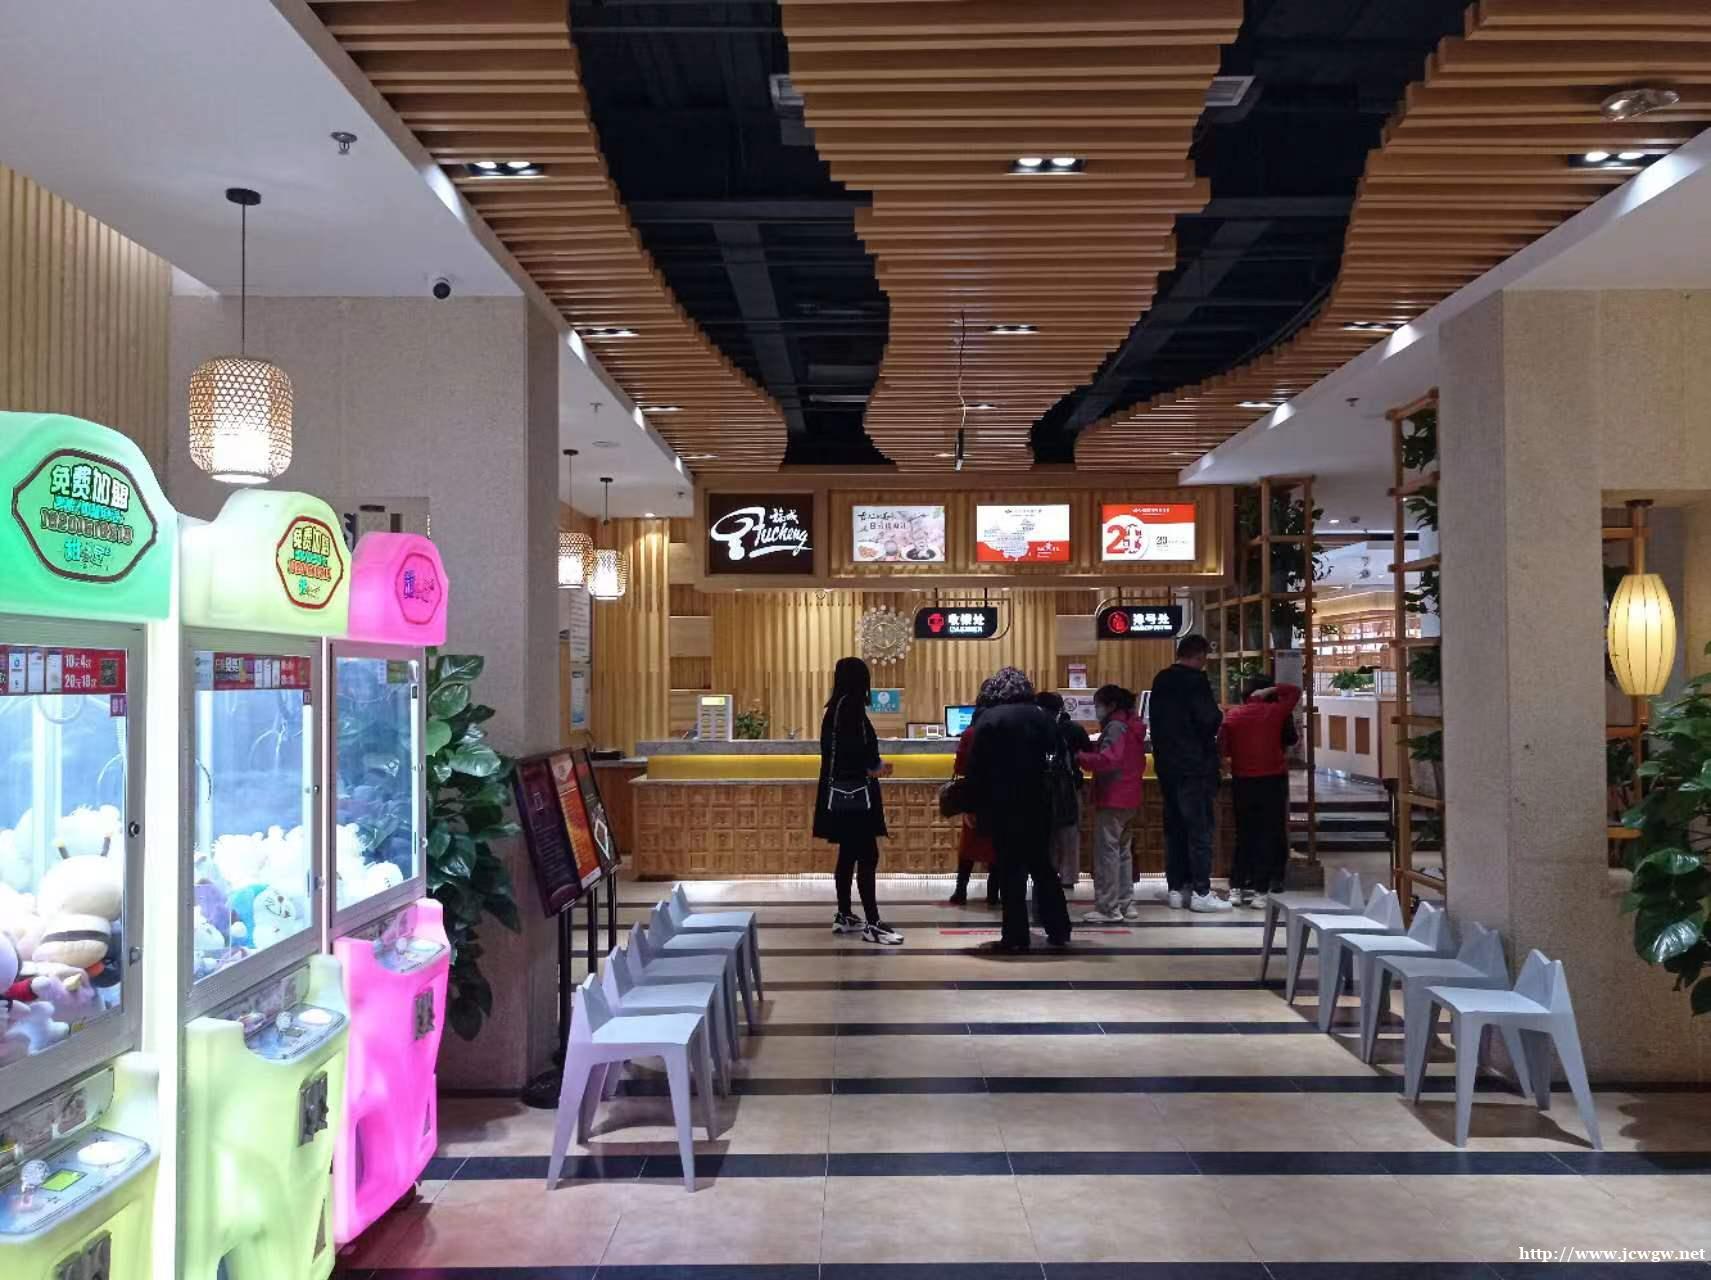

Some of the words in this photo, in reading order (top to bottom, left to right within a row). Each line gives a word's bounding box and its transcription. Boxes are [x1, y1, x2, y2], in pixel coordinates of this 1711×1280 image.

[50, 463, 130, 512] 免费加盟
[293, 525, 330, 558] 免费加盟
